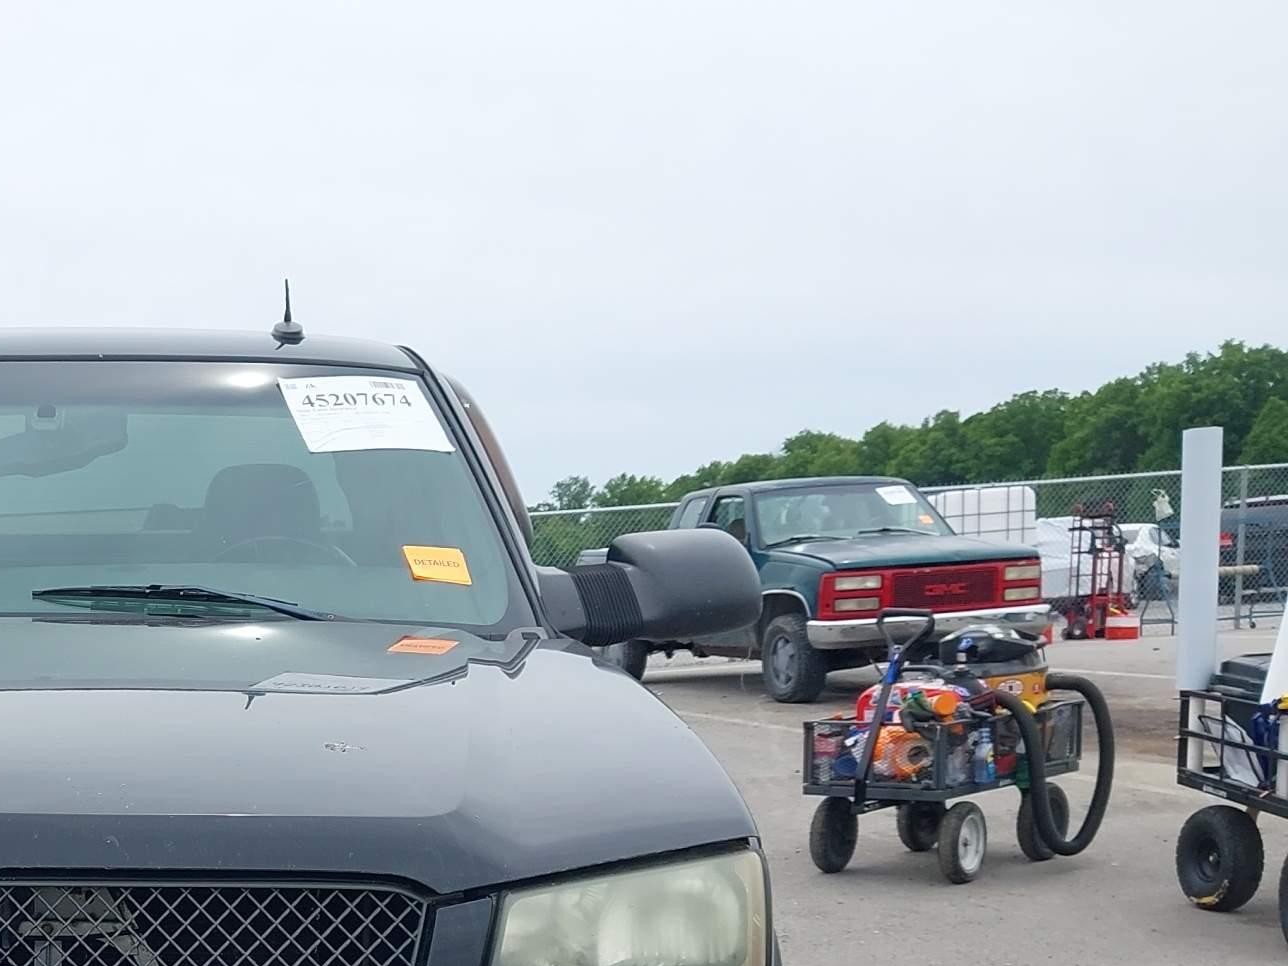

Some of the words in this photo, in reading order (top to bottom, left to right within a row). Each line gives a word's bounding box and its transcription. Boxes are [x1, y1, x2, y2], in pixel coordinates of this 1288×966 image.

[302, 392, 412, 407] 45207674
[413, 559, 460, 568] DETAILED
[925, 583, 968, 595] GMC
